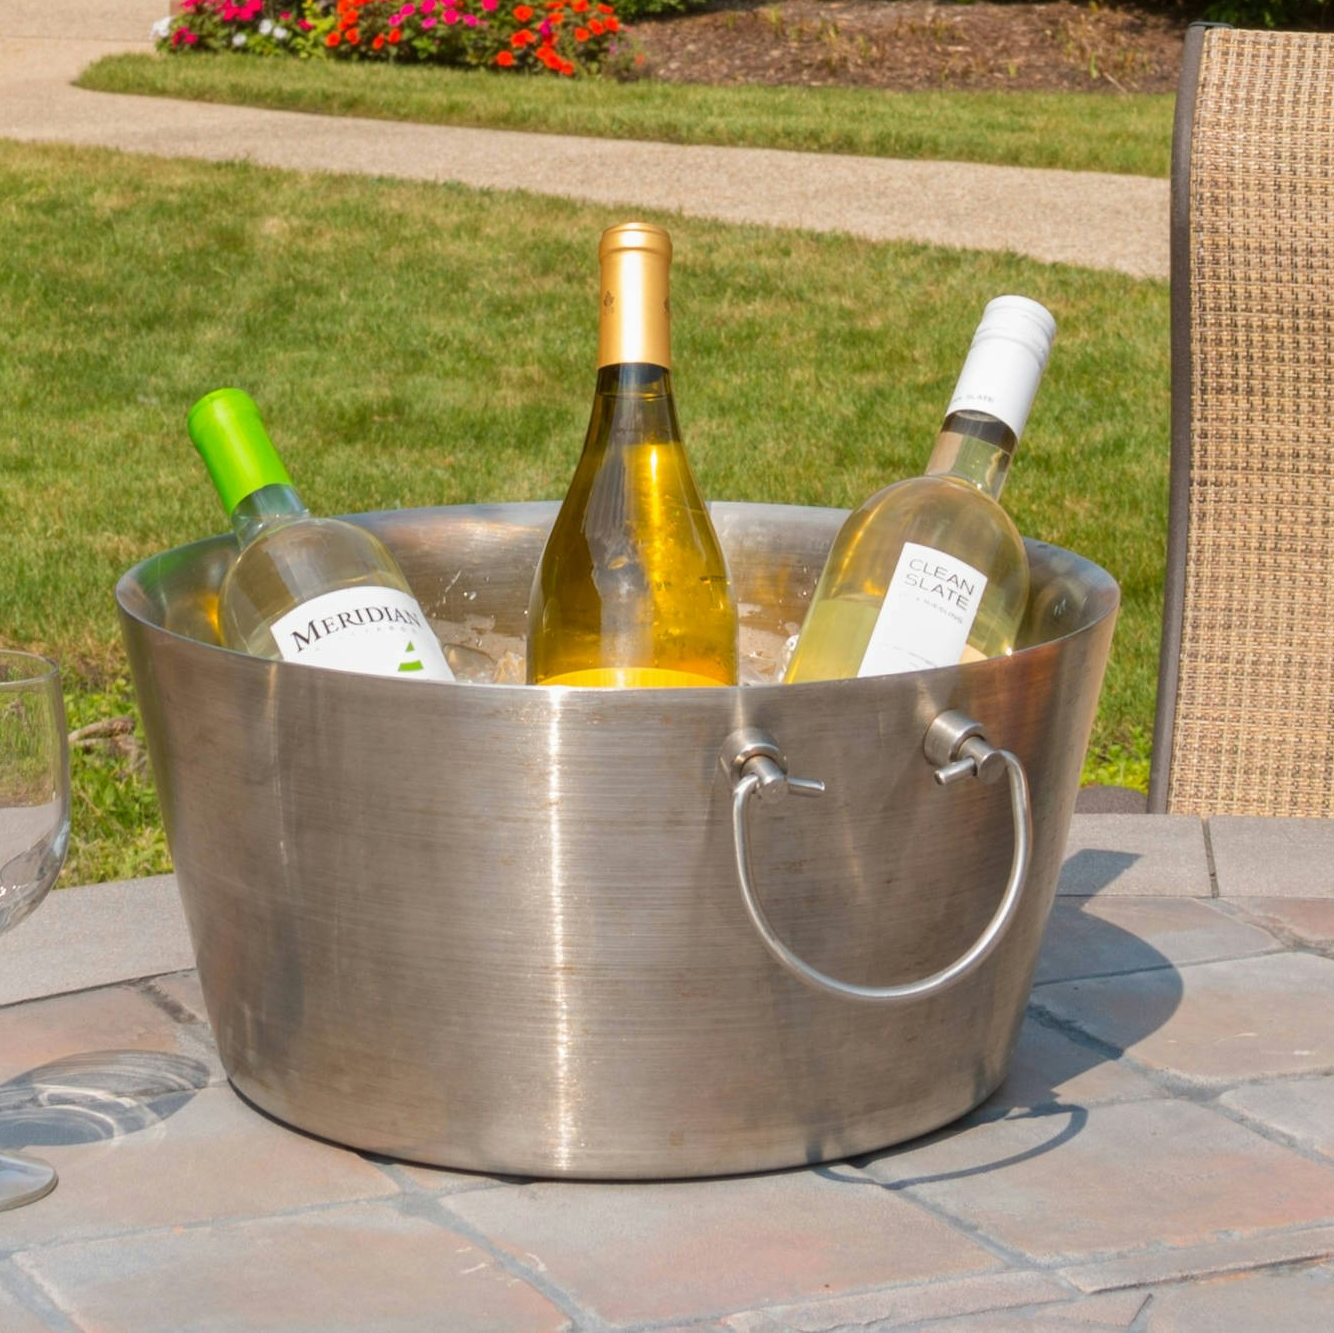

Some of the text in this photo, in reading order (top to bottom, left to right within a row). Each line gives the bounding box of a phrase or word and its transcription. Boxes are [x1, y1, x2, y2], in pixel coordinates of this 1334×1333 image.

[904, 572, 970, 611] SLATE
[909, 558, 975, 596] CLEAN
[290, 606, 421, 653] MERIDIAN
